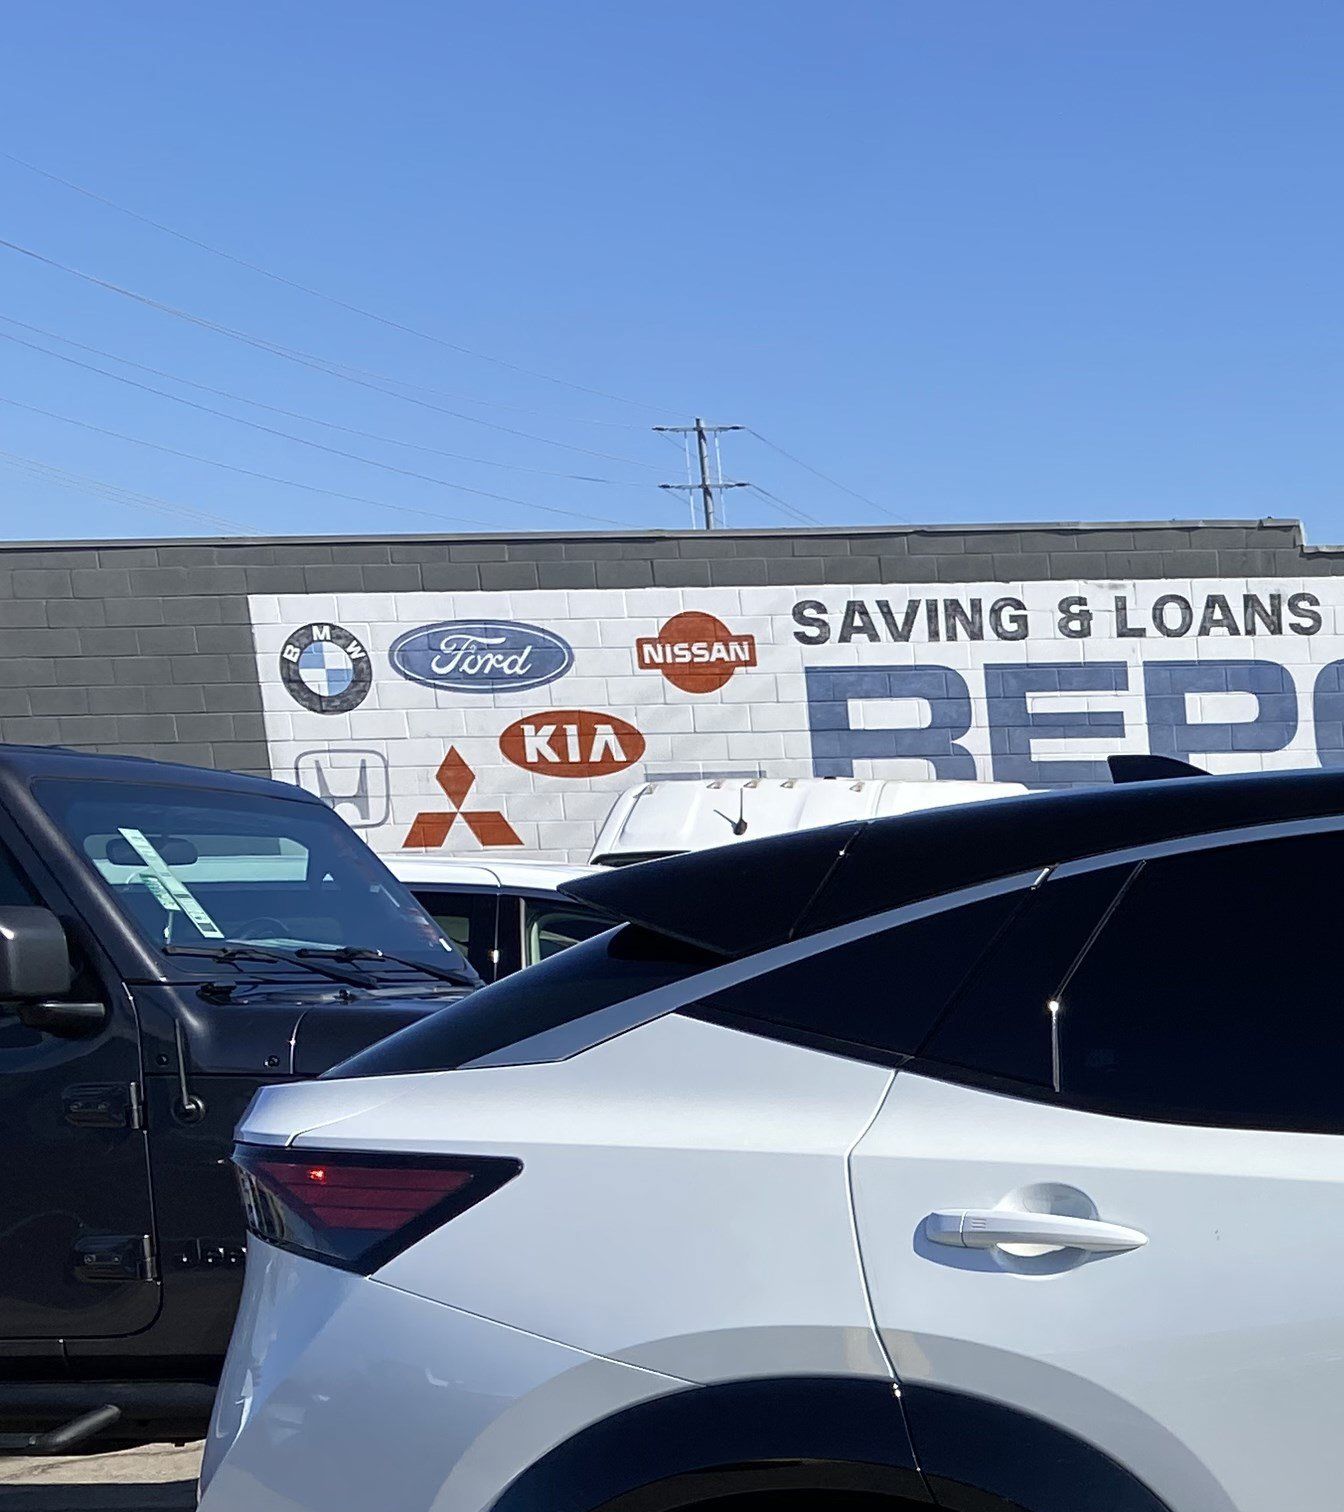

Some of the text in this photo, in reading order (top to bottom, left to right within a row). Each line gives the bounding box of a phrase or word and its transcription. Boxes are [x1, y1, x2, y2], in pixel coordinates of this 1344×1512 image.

[792, 597, 1029, 645] SAVING
[1058, 596, 1093, 639] &
[1115, 592, 1322, 639] LOANS
[431, 634, 533, 675] Ford
[642, 639, 751, 667] NISSAN
[520, 723, 629, 764] KIA
